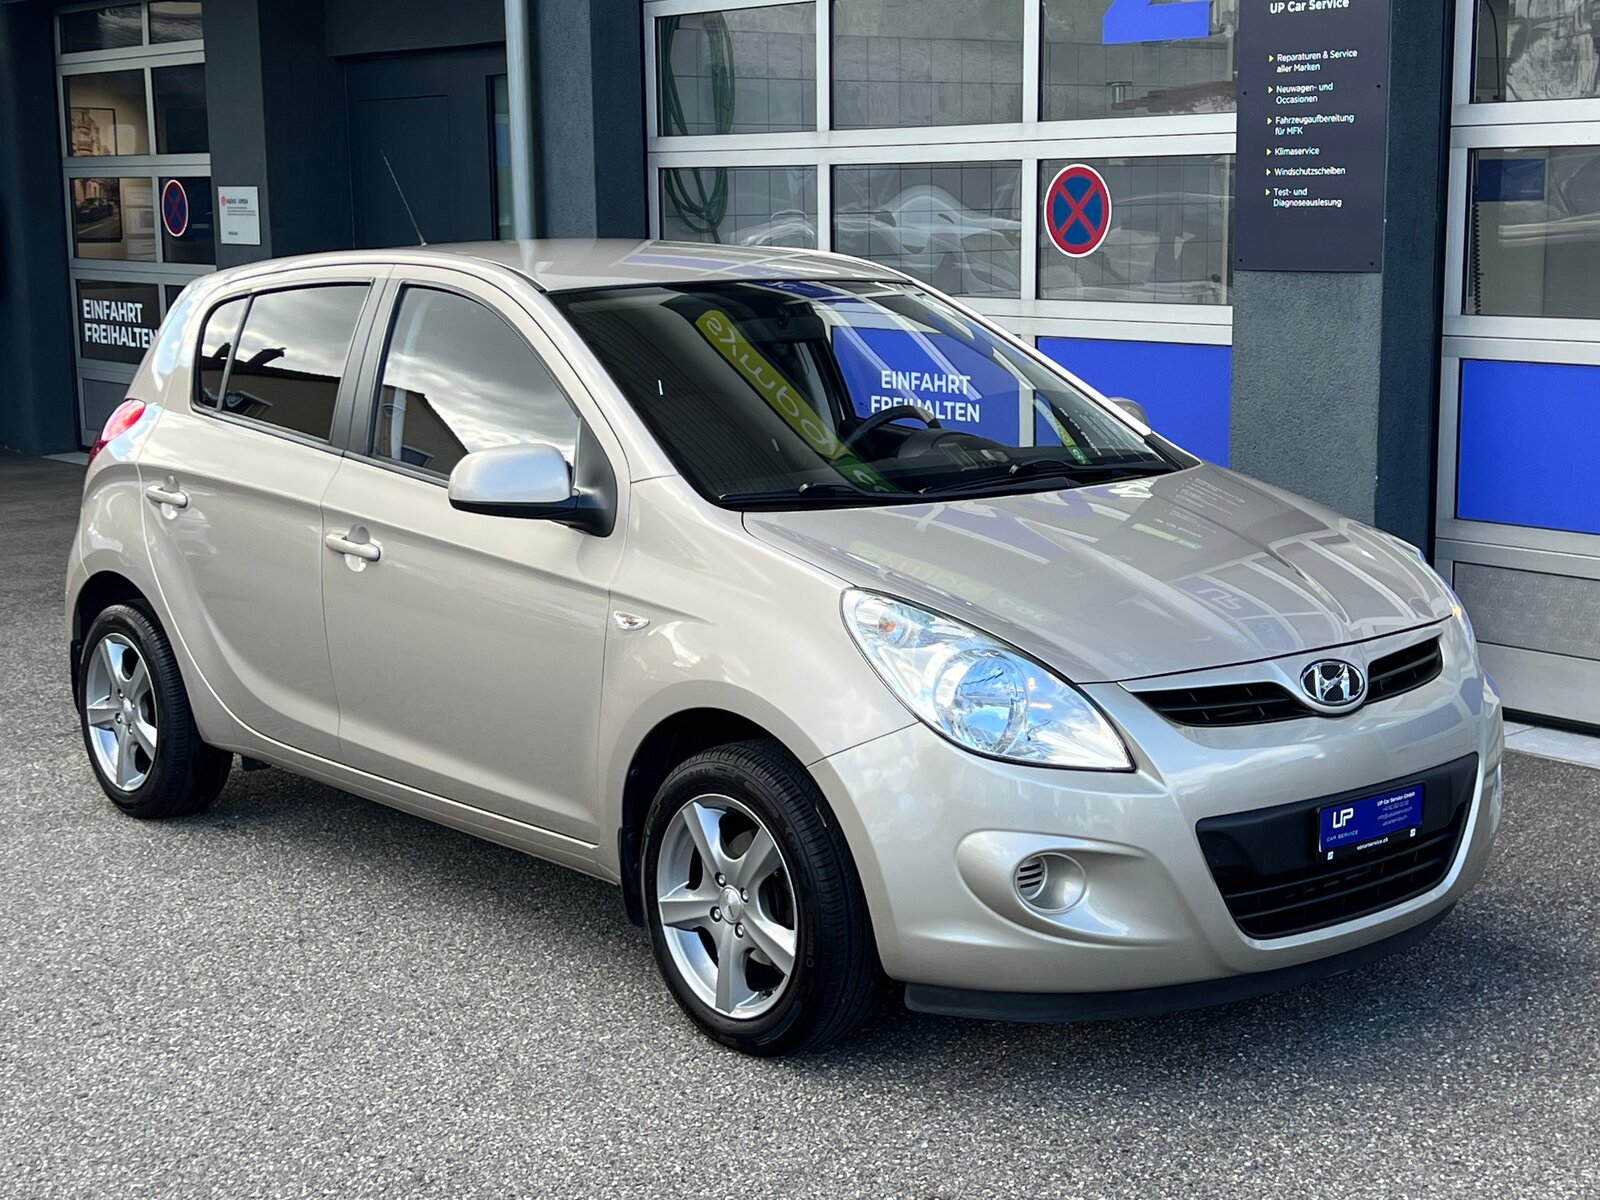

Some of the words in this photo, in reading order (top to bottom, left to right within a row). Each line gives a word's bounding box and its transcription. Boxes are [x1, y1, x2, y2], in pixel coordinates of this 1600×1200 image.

[1270, 2, 1285, 13] UP
[1288, 1, 1306, 13] Car
[1308, 0, 1350, 11] Service
[1277, 53, 1321, 62] Reparaturen
[1323, 51, 1329, 60] &
[1330, 49, 1358, 59] Service
[1276, 64, 1293, 73] aller
[1294, 63, 1321, 72] Marken
[1276, 85, 1317, 94] Neuwagen-
[1319, 82, 1334, 91] und
[1276, 95, 1318, 105] Occasionen
[1275, 114, 1354, 125] Fahrzeugaufbereitung
[1274, 126, 1286, 136] für
[1286, 126, 1304, 135] MFK
[1274, 146, 1320, 156] Klimaservice
[1274, 166, 1346, 177] Windschutzscheiben
[1273, 188, 1292, 197] Test-
[1293, 187, 1308, 196] und
[1273, 197, 1342, 208] Diagnoseauslesung
[83, 299, 143, 323] EINFAHRT
[881, 370, 971, 395] EINFAHRT
[1332, 807, 1354, 828] UP
